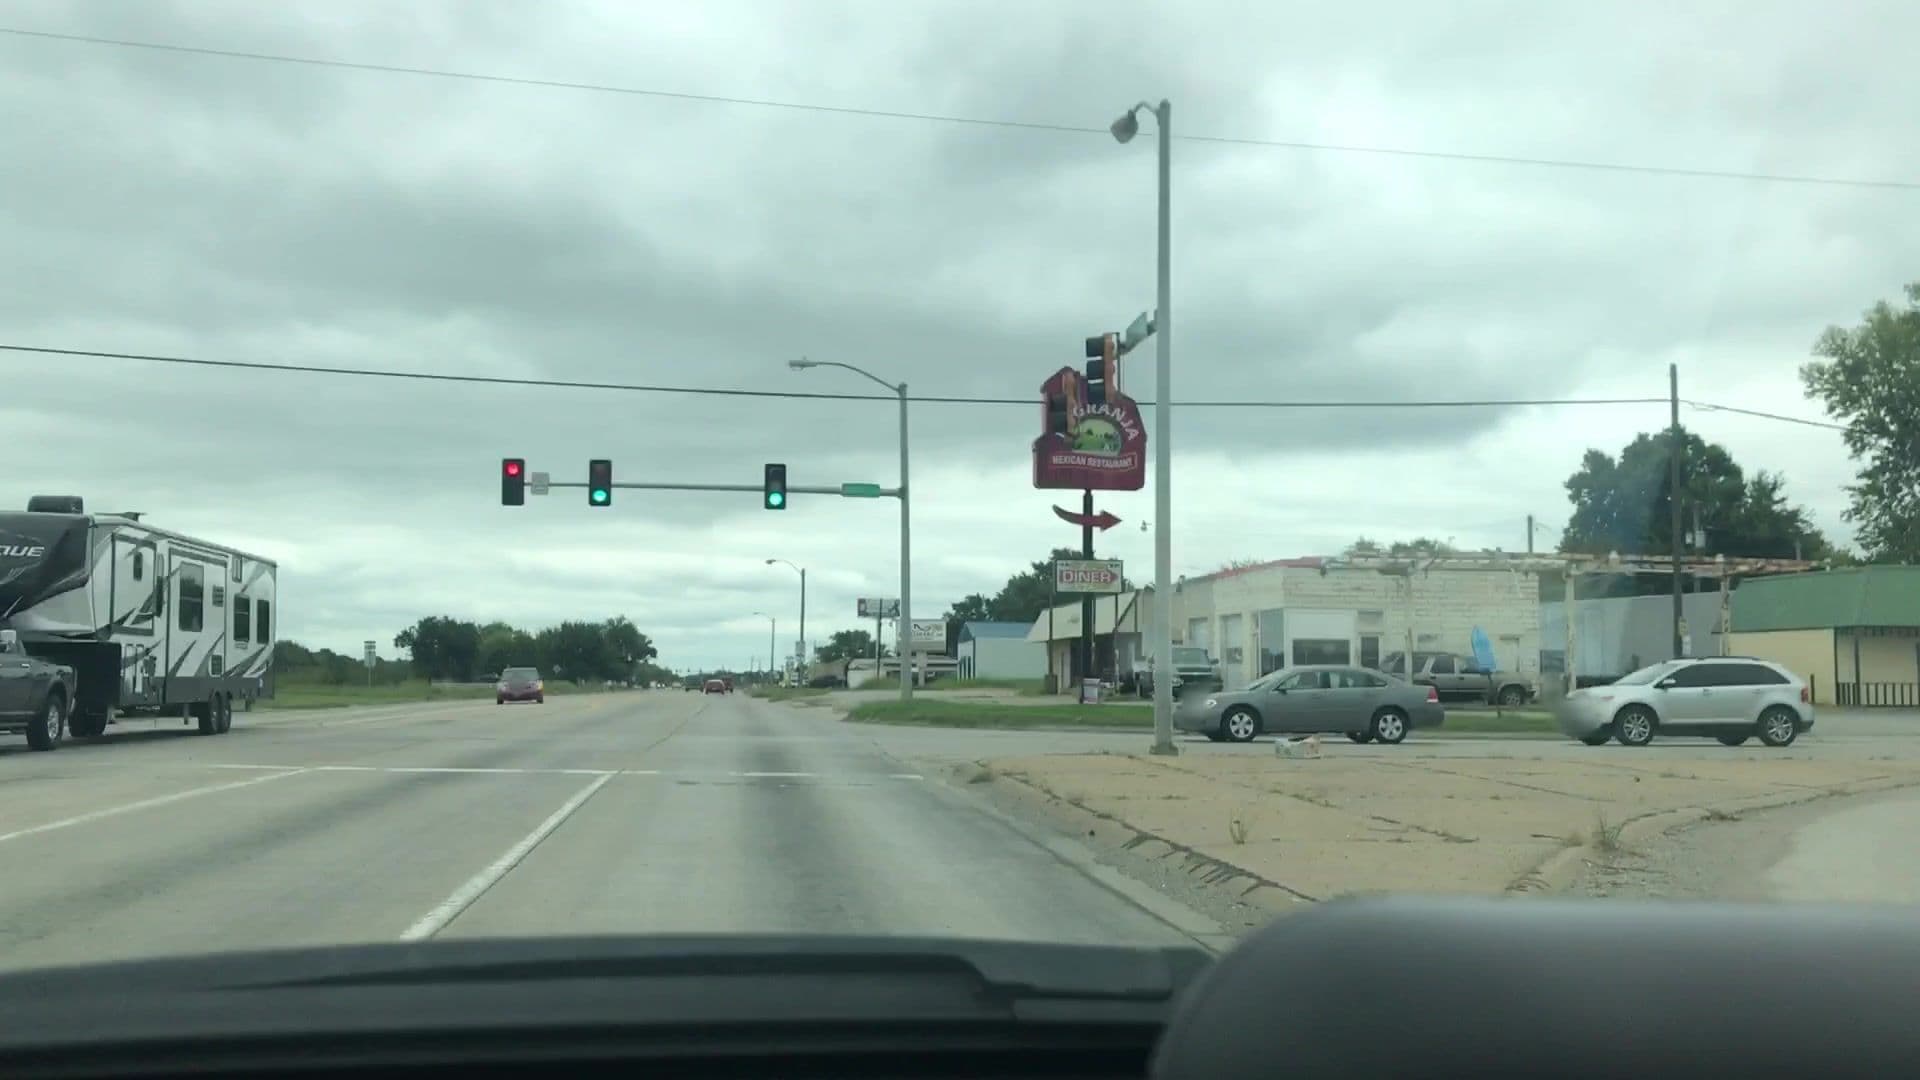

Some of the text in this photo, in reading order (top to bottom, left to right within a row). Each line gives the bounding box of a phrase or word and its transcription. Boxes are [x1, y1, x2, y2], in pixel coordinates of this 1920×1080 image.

[1073, 403, 1140, 441] GRANJA
[1052, 455, 1132, 468] MEXICAN RESTAURANT
[1062, 570, 1111, 583] DINER
